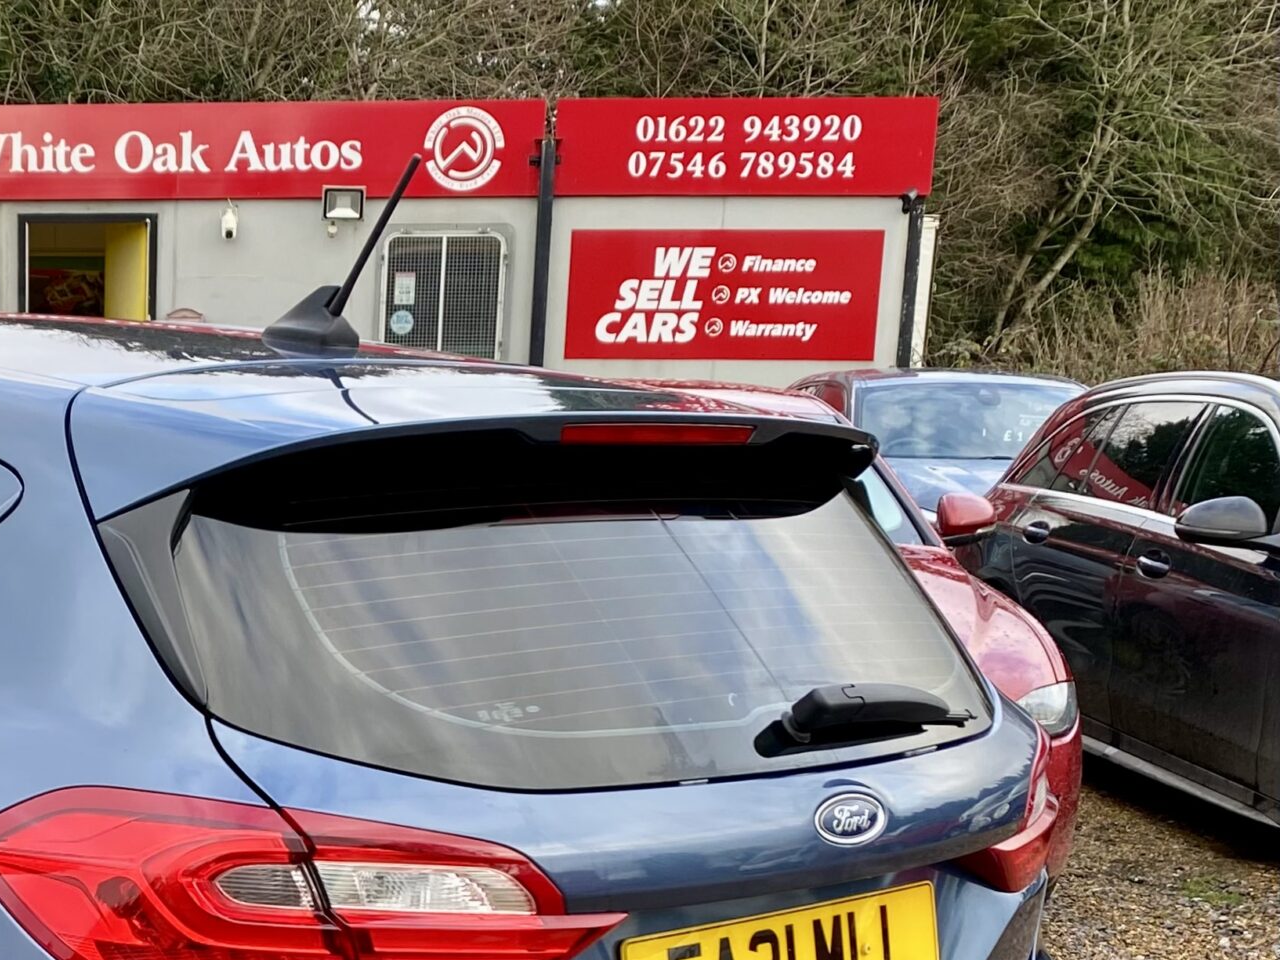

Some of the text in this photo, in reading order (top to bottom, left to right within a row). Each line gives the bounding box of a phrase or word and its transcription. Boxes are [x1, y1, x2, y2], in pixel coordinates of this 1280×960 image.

[635, 114, 863, 143] 01622 943920
[114, 130, 210, 174] Oak
[224, 130, 362, 172] Autos
[627, 151, 856, 179] 07546 789584
[653, 247, 717, 278] WE
[740, 255, 817, 273] Finance
[614, 279, 703, 311] SELL
[734, 287, 853, 305] PX Welcome
[594, 312, 700, 343] CARS
[729, 320, 818, 342] Warranty
[832, 804, 871, 835] Ford
